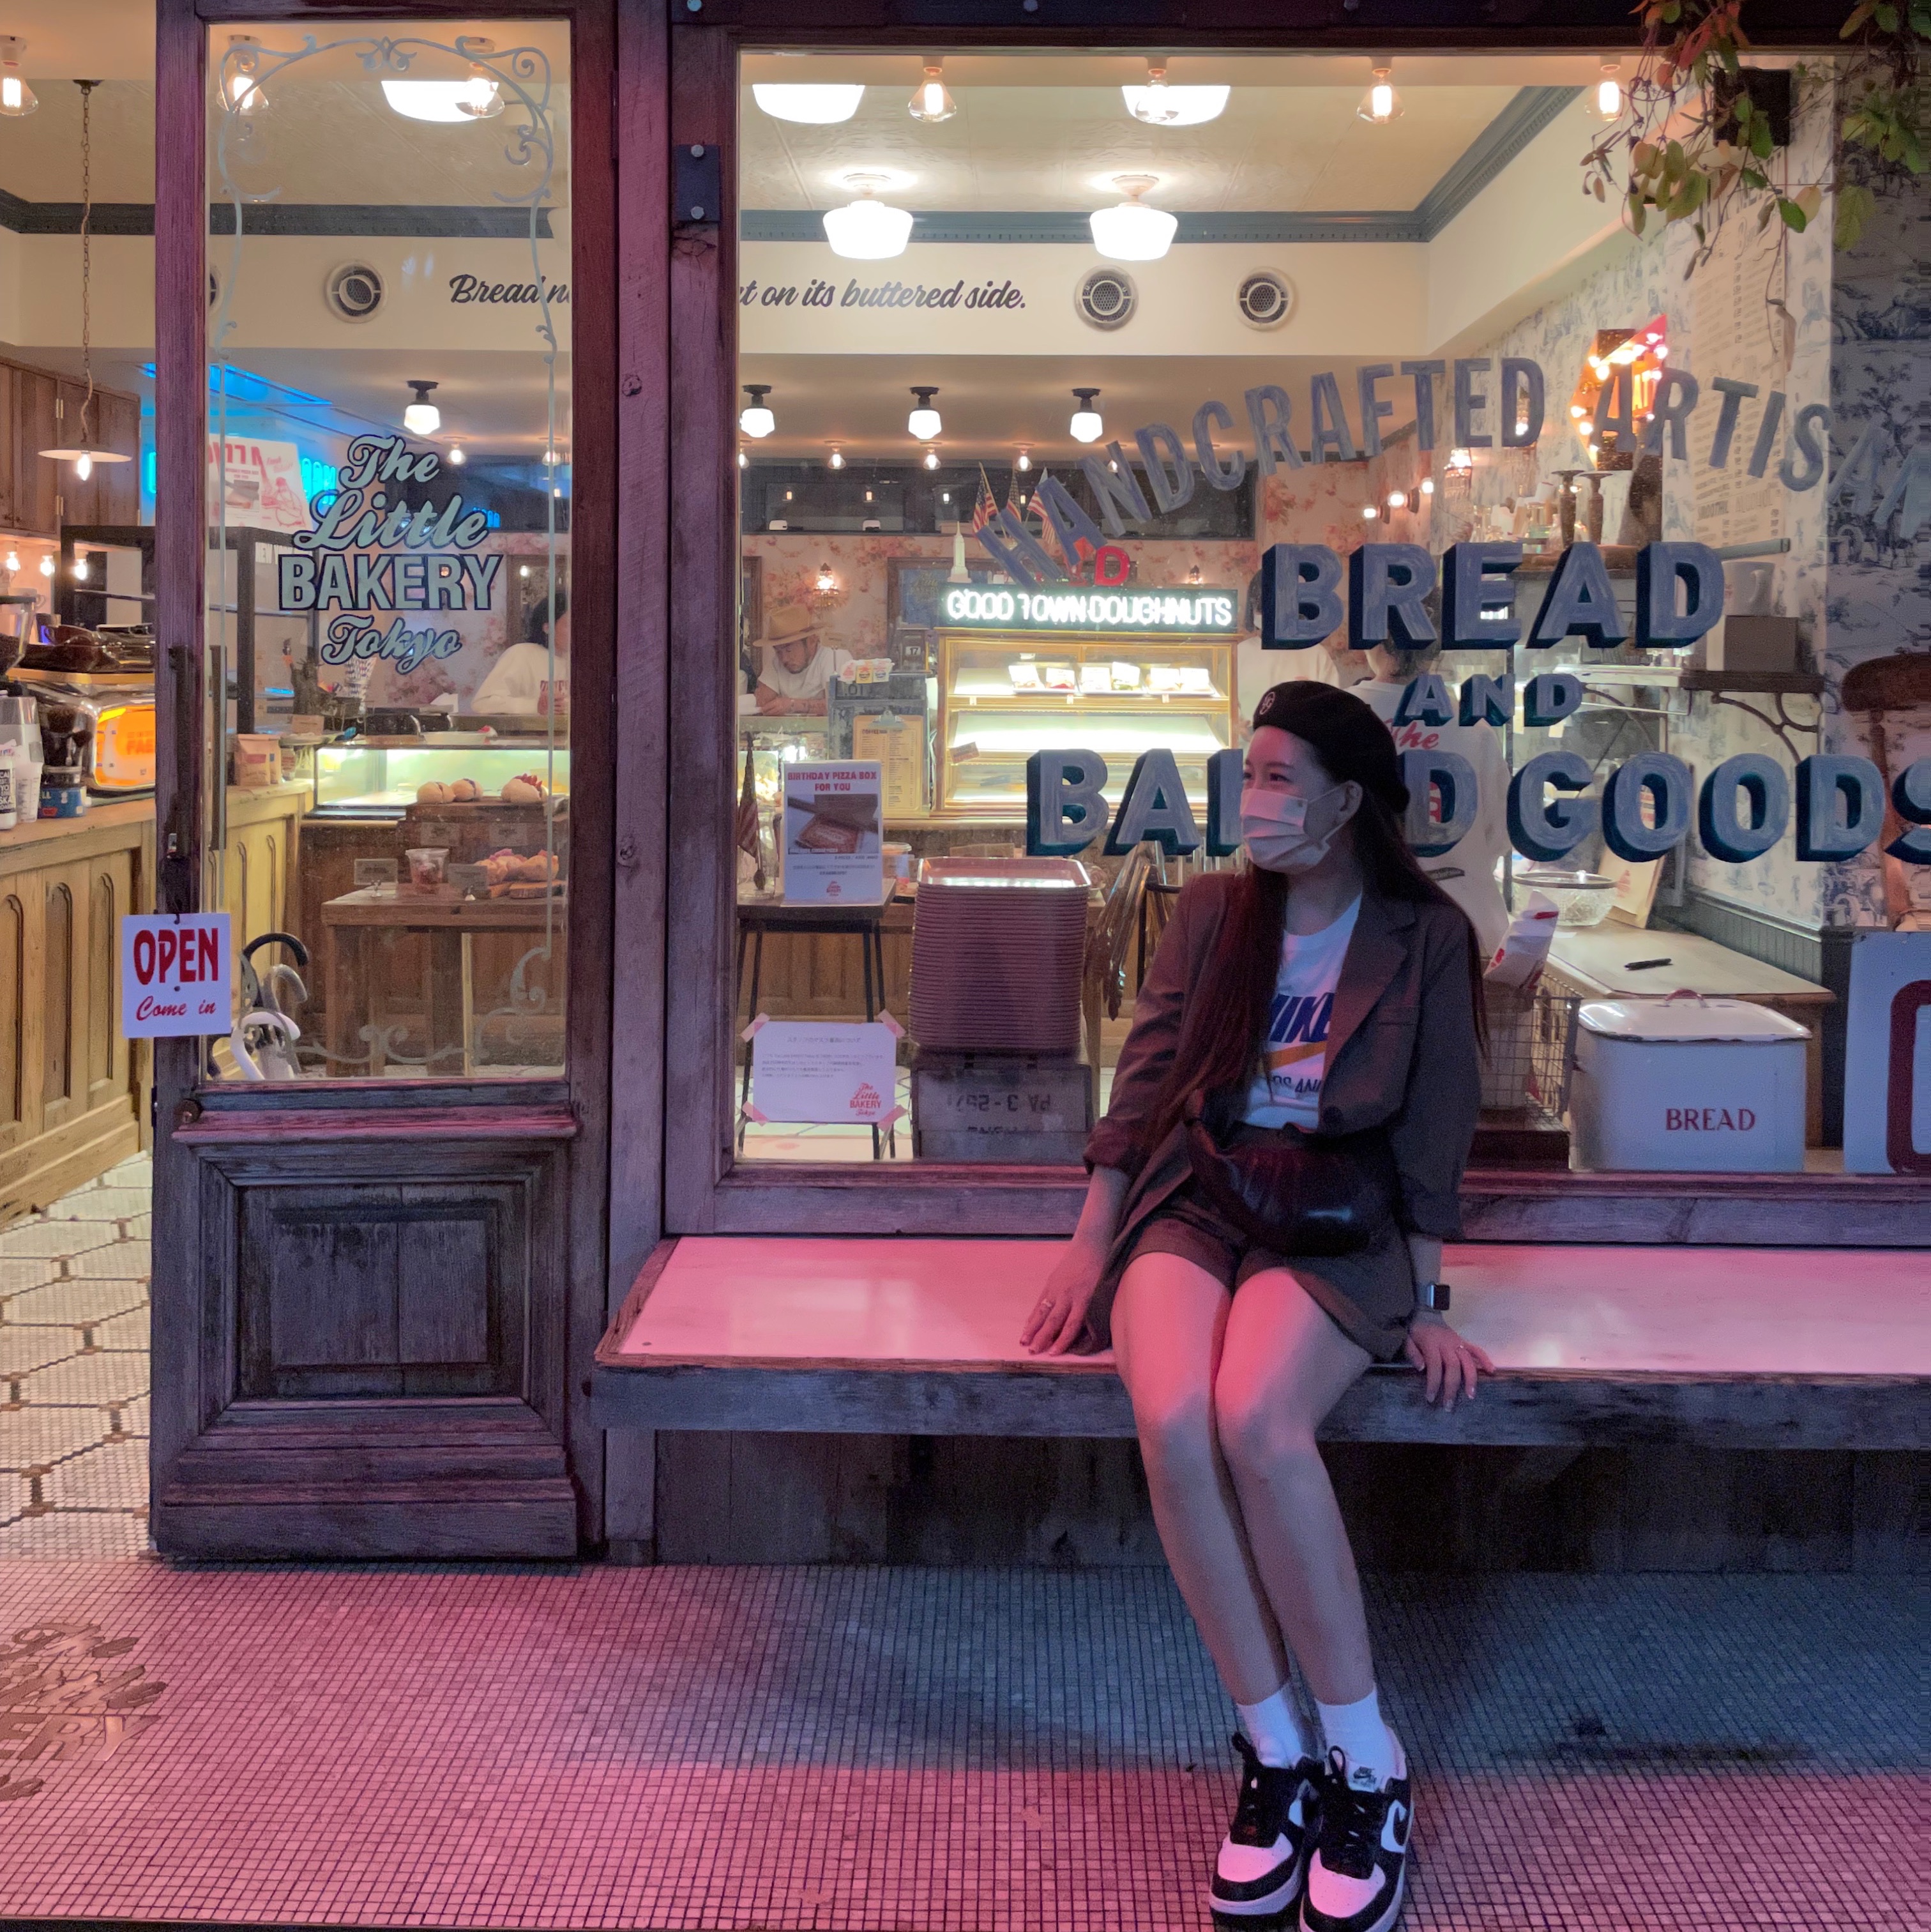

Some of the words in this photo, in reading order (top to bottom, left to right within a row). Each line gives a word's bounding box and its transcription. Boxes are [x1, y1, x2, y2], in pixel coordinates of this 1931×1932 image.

[761, 285, 798, 306] on
[802, 278, 836, 307] its
[840, 278, 964, 308] buttered
[965, 280, 1026, 308] side.
[339, 434, 440, 489] The
[975, 356, 1546, 591] HANDCRAFTED
[292, 487, 490, 551] Little
[278, 554, 504, 611] BAKERY
[947, 589, 1015, 621] GOOD
[1017, 592, 1086, 623] TOWN
[1087, 595, 1233, 627] DOUGHNUTS
[1261, 542, 1724, 650] BREAD
[321, 614, 462, 675] Tokyo
[1392, 673, 1583, 727] AND
[787, 772, 830, 780] BIRTHDAY
[832, 771, 857, 780] PIZZA
[859, 771, 877, 780] BOX
[815, 783, 831, 791] FOR
[833, 783, 851, 791] YOU
[1027, 748, 1479, 859] BAD
[133, 927, 219, 985] OPEN
[136, 996, 188, 1021] Come
[199, 999, 216, 1015] in
[849, 1100, 882, 1109] BAKERY
[852, 1091, 881, 1100] Little
[1665, 1107, 1756, 1131] BREAD
